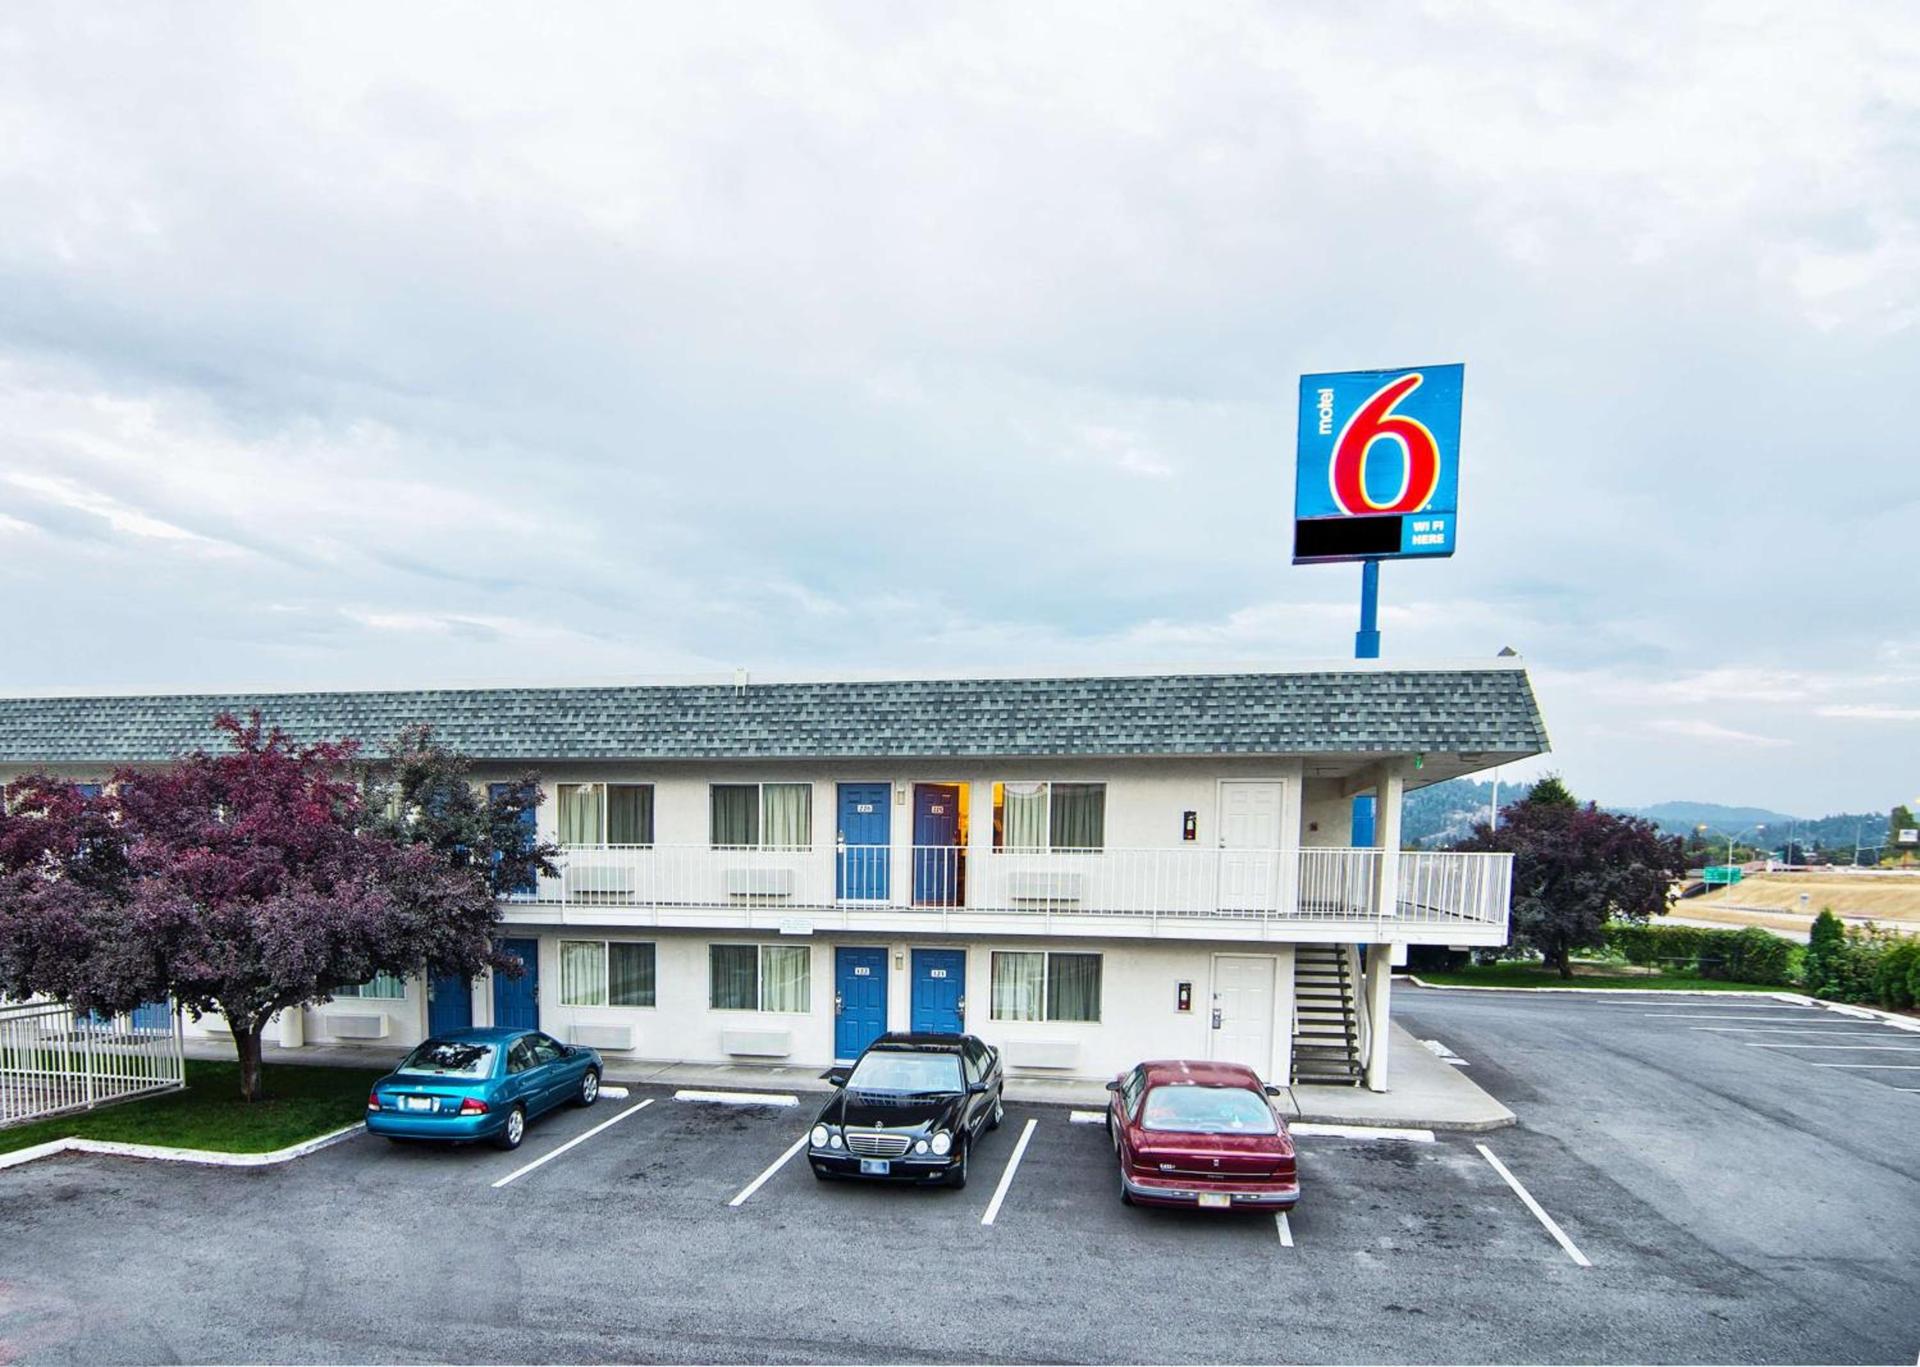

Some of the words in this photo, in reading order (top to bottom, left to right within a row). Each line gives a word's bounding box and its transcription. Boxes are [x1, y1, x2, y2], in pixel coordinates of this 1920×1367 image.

[1317, 388, 1334, 435] motel
[1328, 372, 1441, 516] 6
[1412, 533, 1445, 545] HERE
